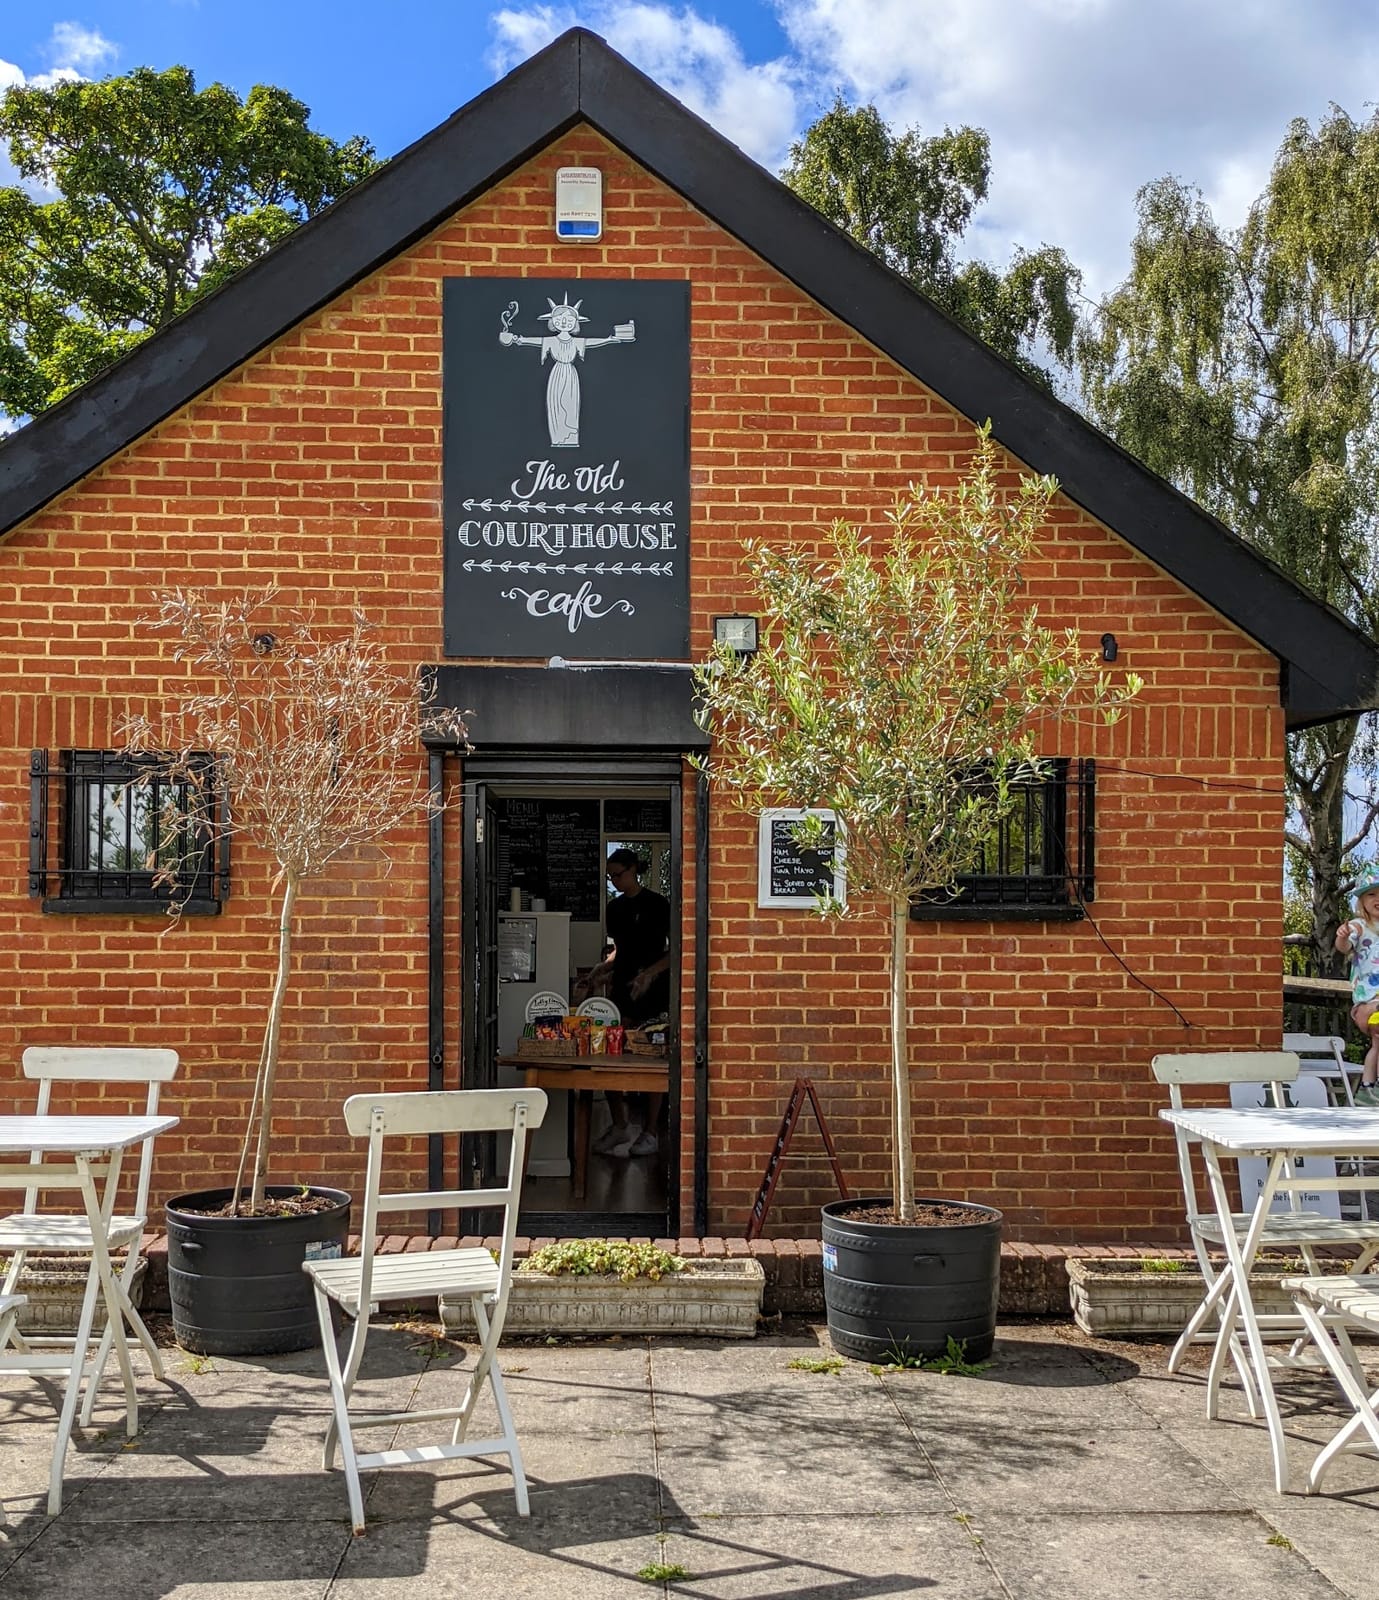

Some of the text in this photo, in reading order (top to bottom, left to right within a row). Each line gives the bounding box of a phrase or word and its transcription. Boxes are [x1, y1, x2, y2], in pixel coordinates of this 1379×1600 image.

[511, 459, 624, 499] The Old
[458, 520, 677, 556] COURTHOUSE
[508, 581, 625, 633] cafe
[506, 799, 540, 815] MENU
[773, 848, 789, 856] HAM
[773, 856, 801, 864] CHEESE
[773, 865, 814, 875] TUNA MAYO
[1304, 1192, 1320, 1201] Farm
